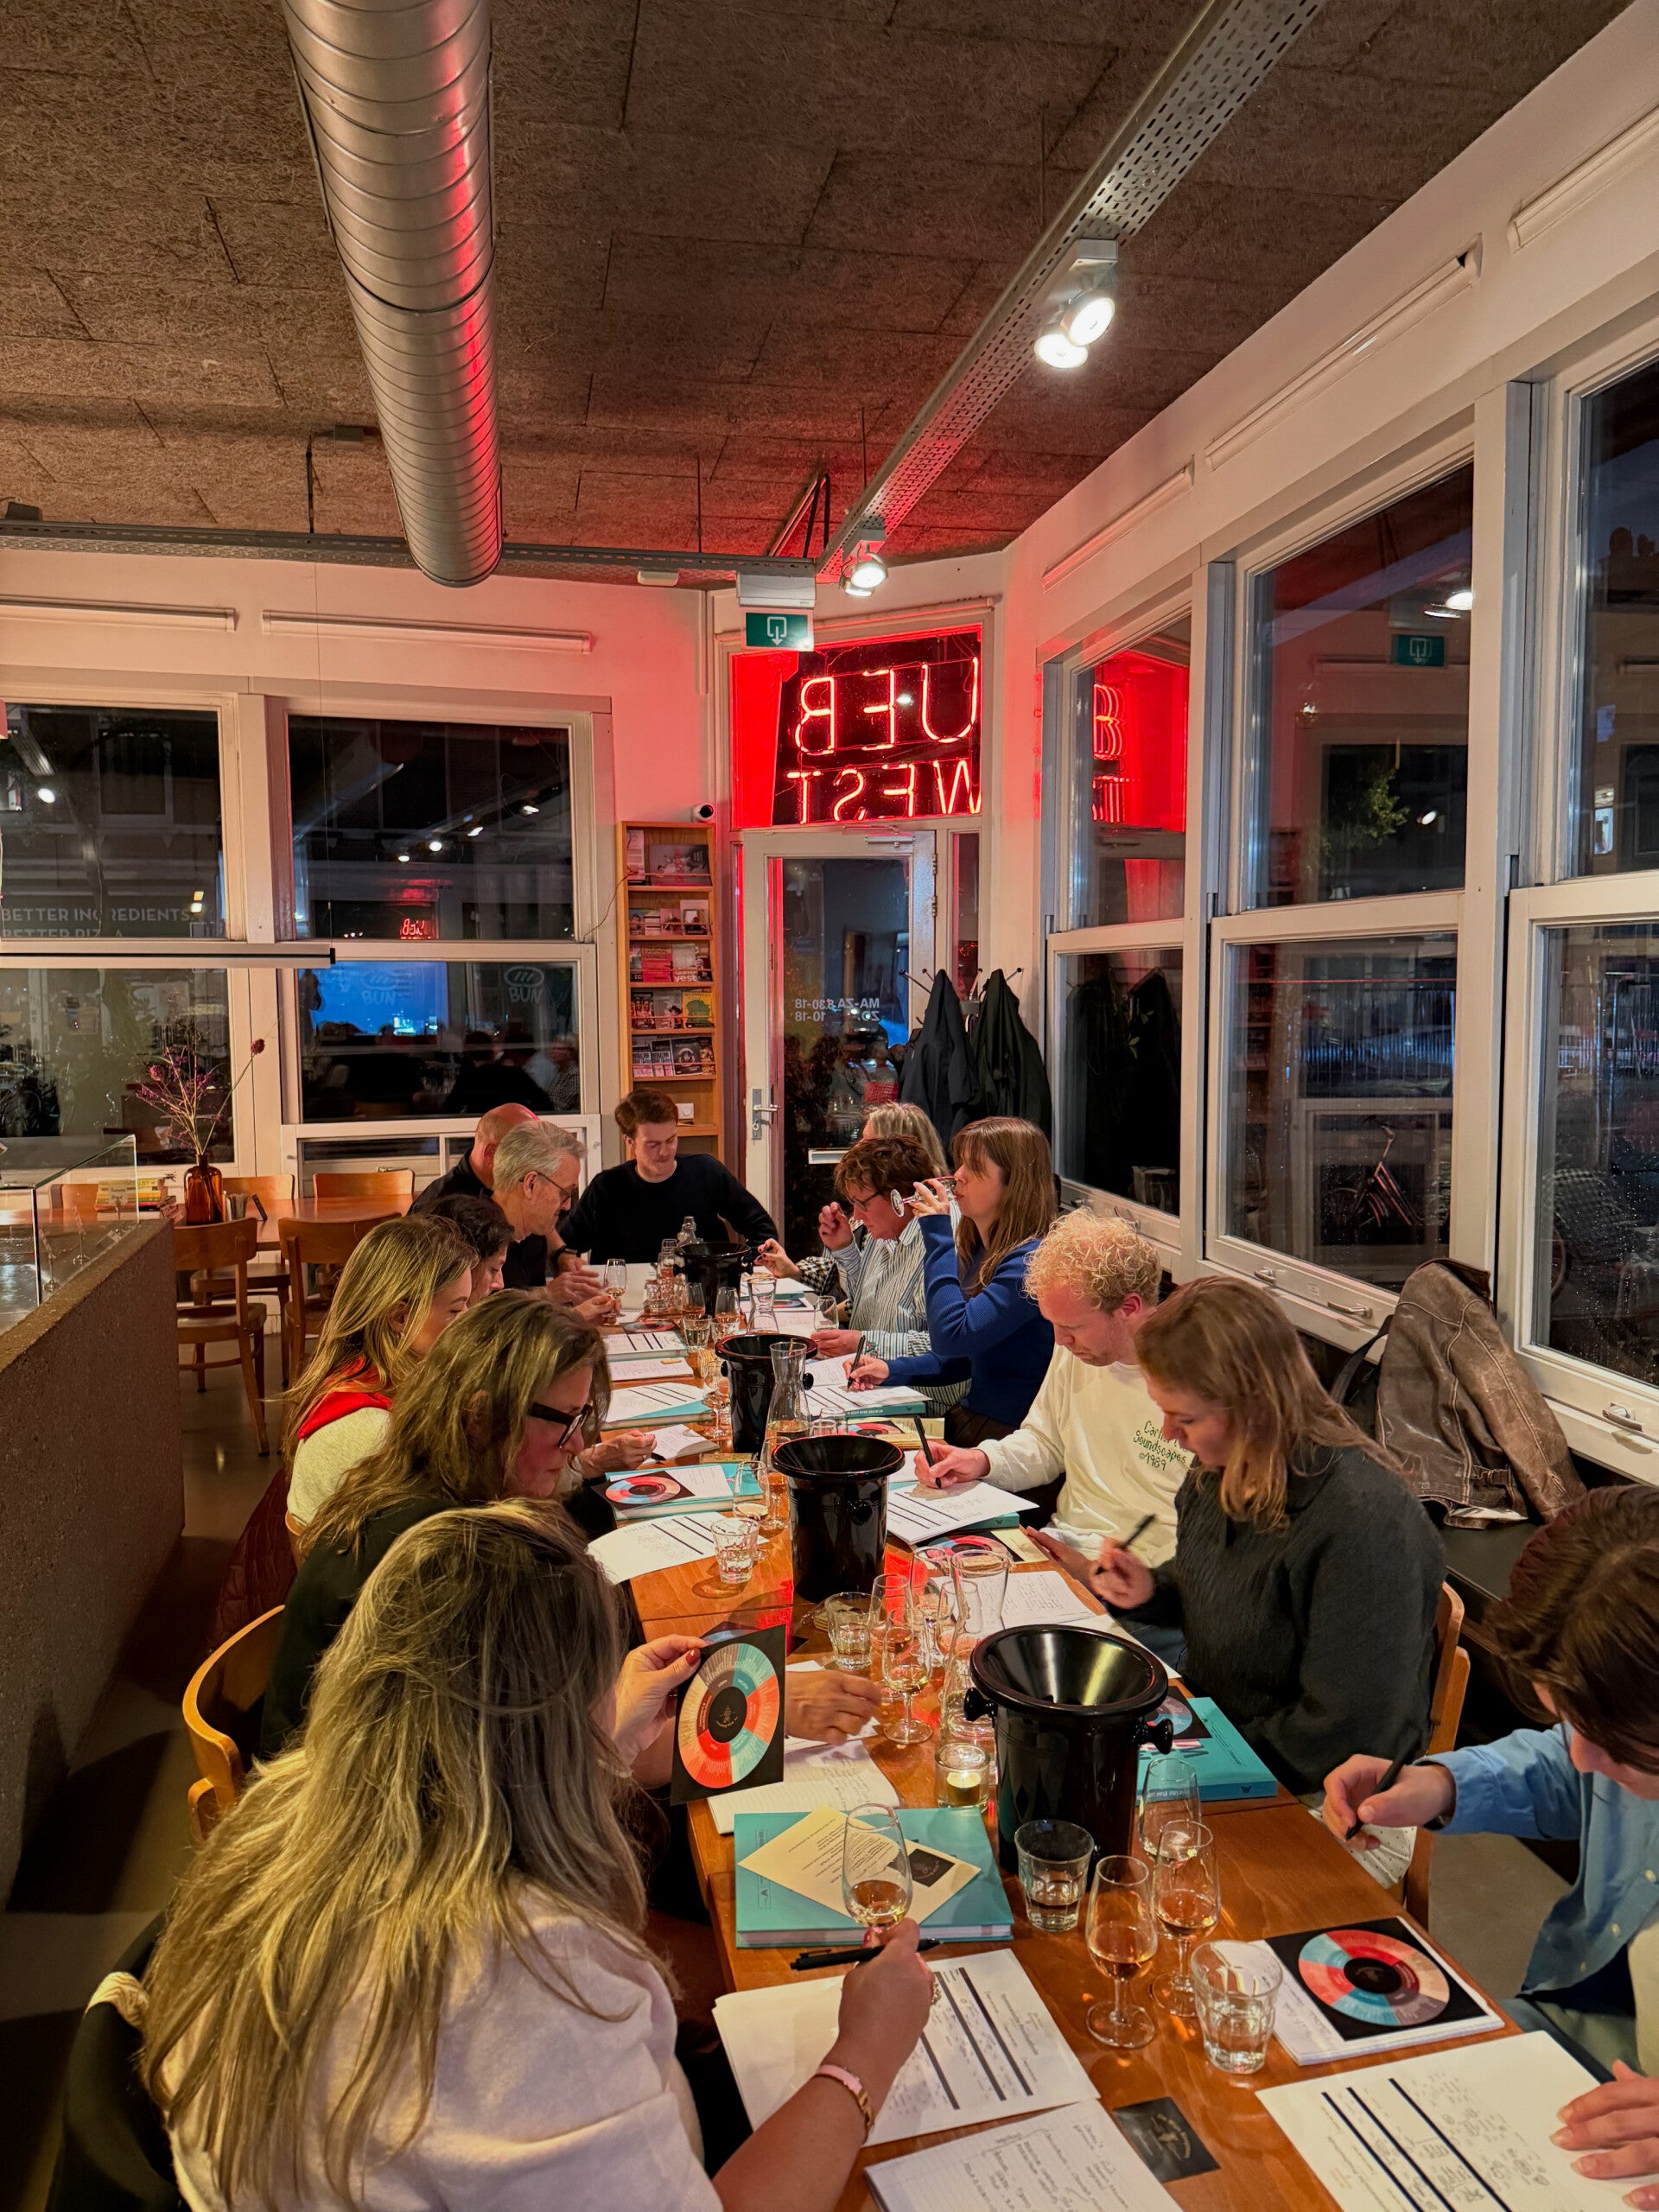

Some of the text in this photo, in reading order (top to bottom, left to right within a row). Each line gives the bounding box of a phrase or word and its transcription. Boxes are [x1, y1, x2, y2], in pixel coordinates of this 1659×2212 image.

[1, 908, 69, 922] BETTER
[362, 990, 397, 1005] BUN
[508, 987, 543, 1004] BUN
[1133, 1430, 1187, 1464] Soundscapes
